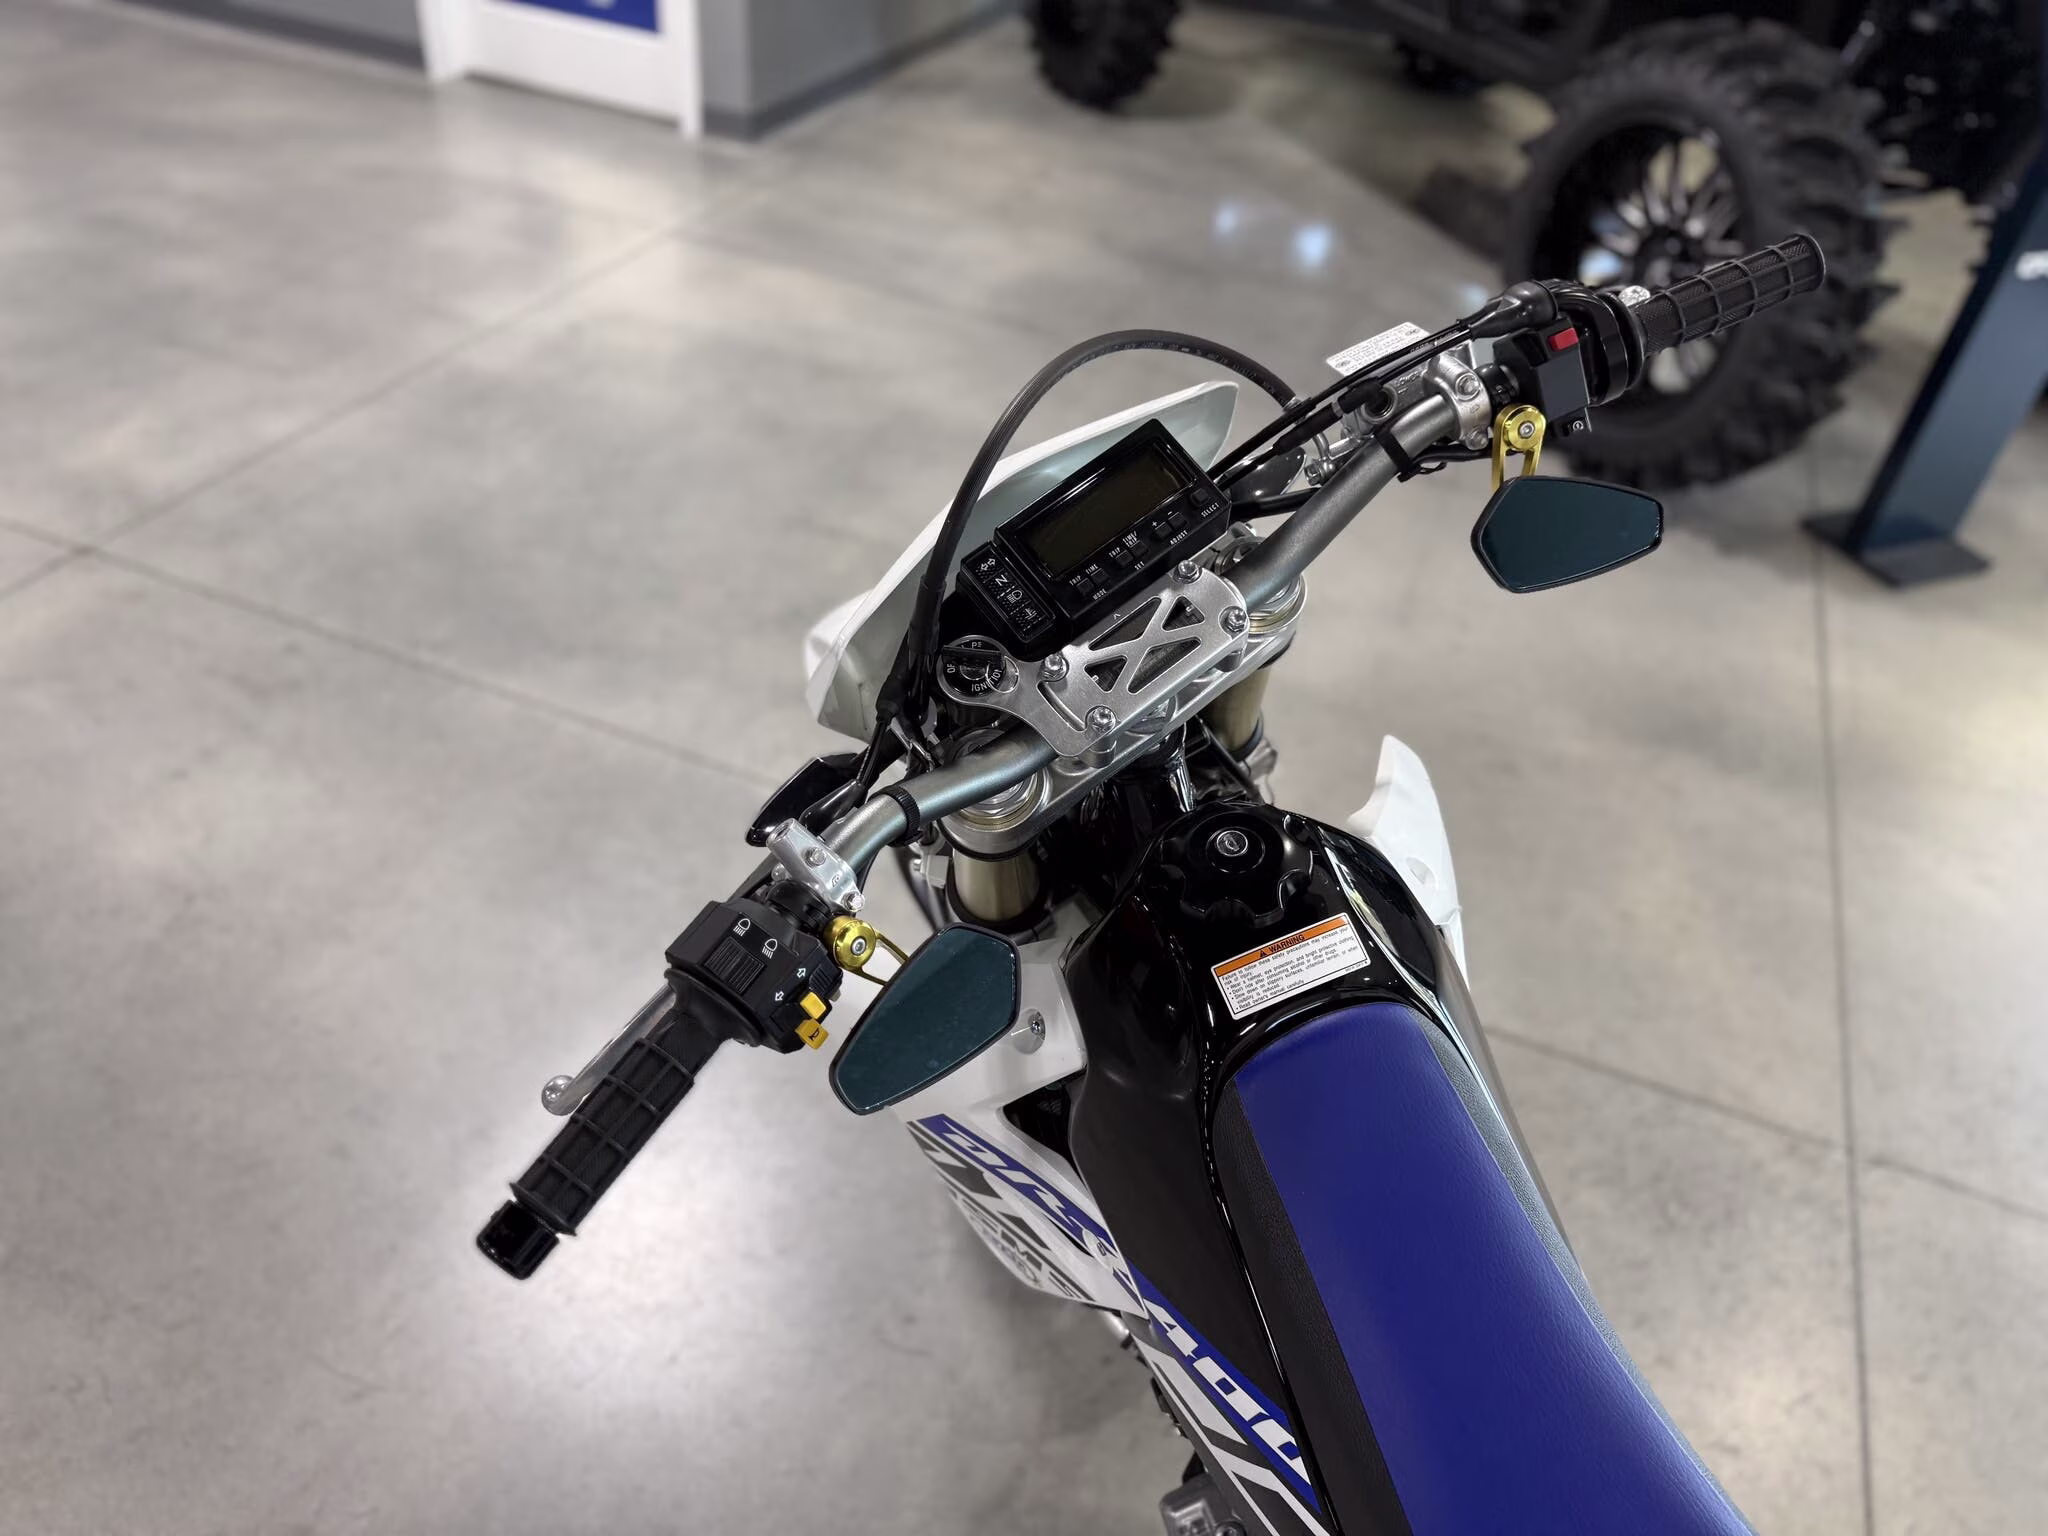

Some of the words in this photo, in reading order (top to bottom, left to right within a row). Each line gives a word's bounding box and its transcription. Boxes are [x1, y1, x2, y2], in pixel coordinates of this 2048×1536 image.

[1201, 502, 1220, 518] SELECT
[1169, 530, 1188, 546] ADJUST
[1108, 546, 1121, 558] TRIP
[1134, 560, 1145, 571] SET
[995, 573, 1008, 587] N
[1069, 575, 1081, 586] TRIP
[1085, 563, 1099, 575] TIME
[1092, 588, 1107, 601] MODE
[1268, 933, 1305, 953] WARNING
